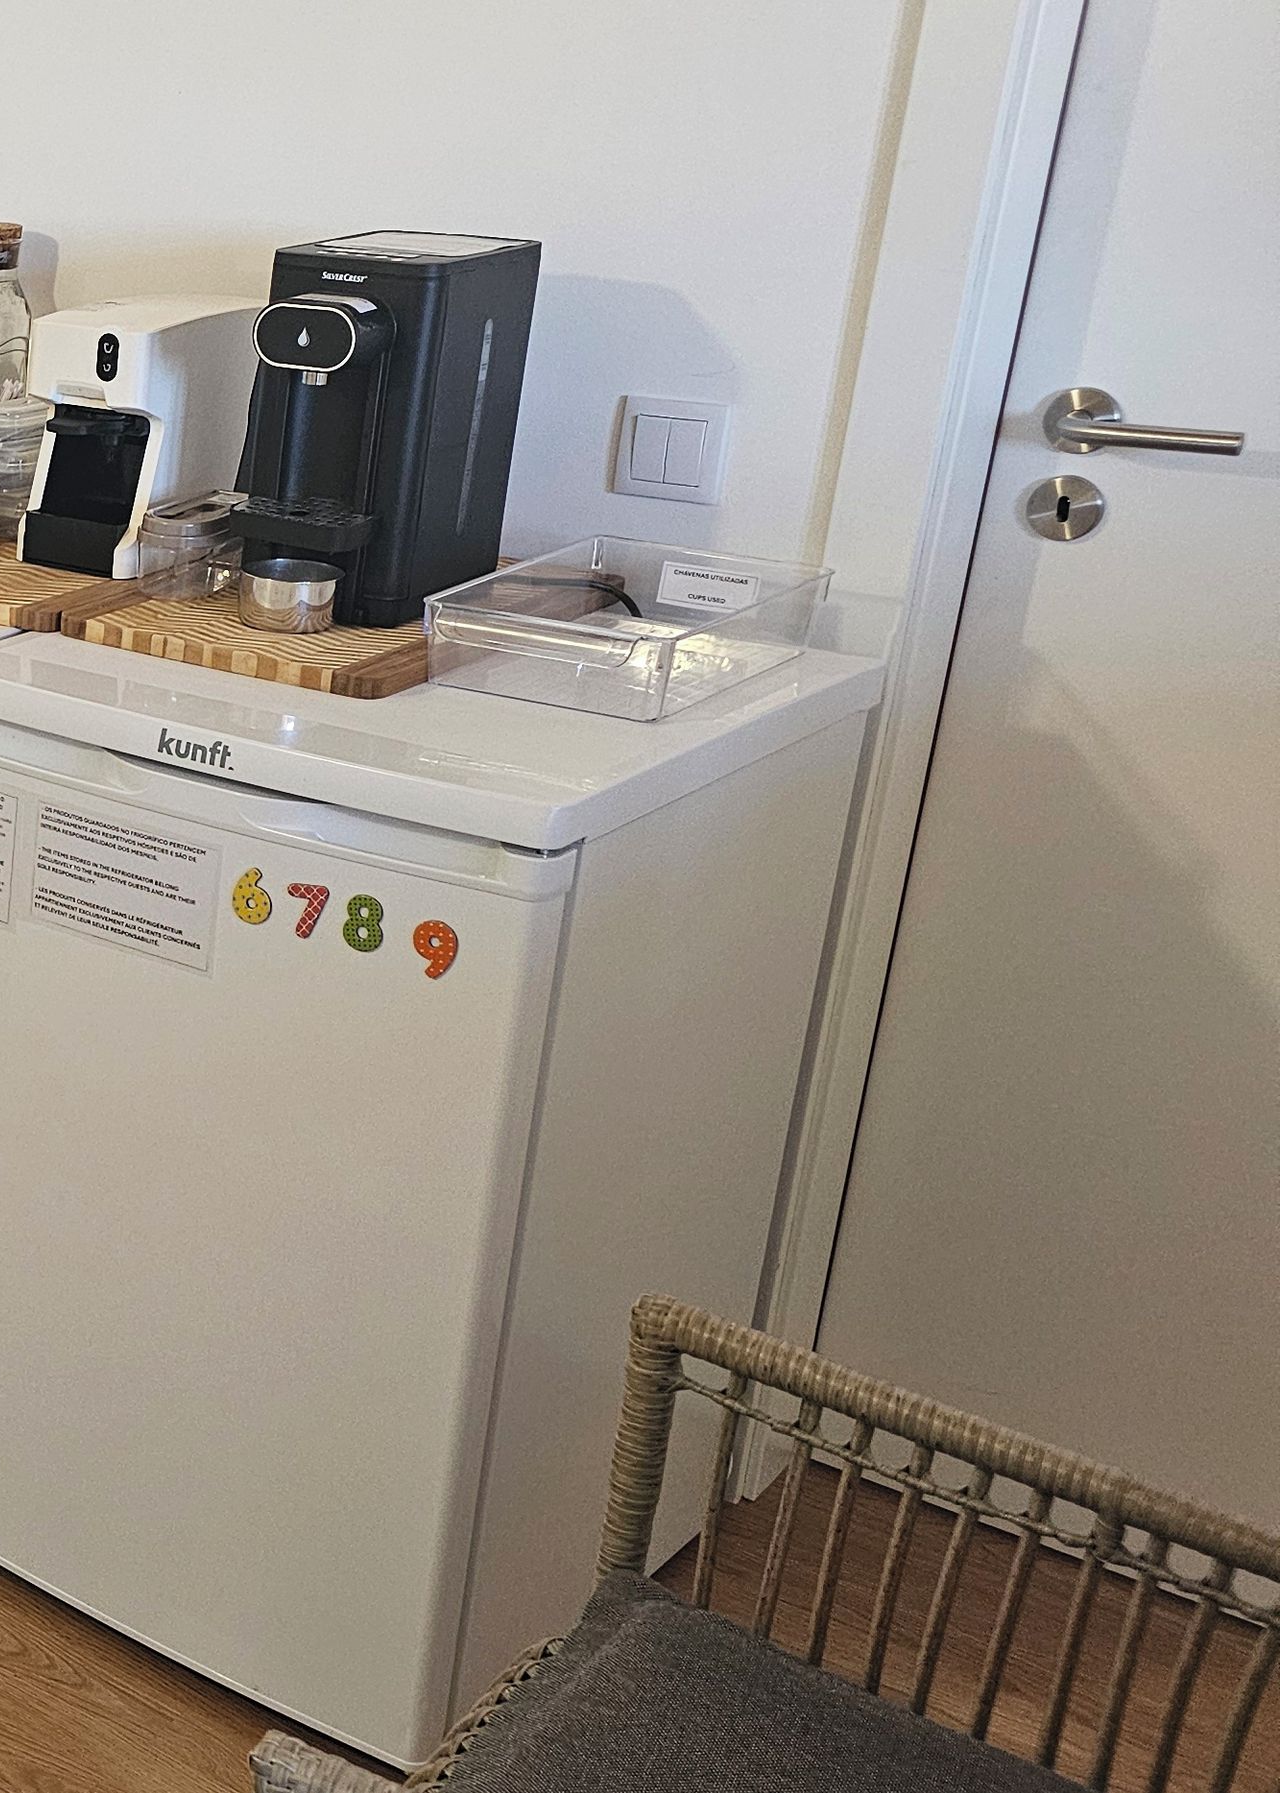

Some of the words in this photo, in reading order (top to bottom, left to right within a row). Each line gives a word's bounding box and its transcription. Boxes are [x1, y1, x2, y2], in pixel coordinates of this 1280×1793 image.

[710, 574, 748, 585] UTILIZADAS
[688, 593, 706, 601] CUPS
[232, 867, 272, 925] 6
[287, 883, 330, 939] 7
[343, 894, 383, 952] 8
[413, 920, 458, 979] 9
